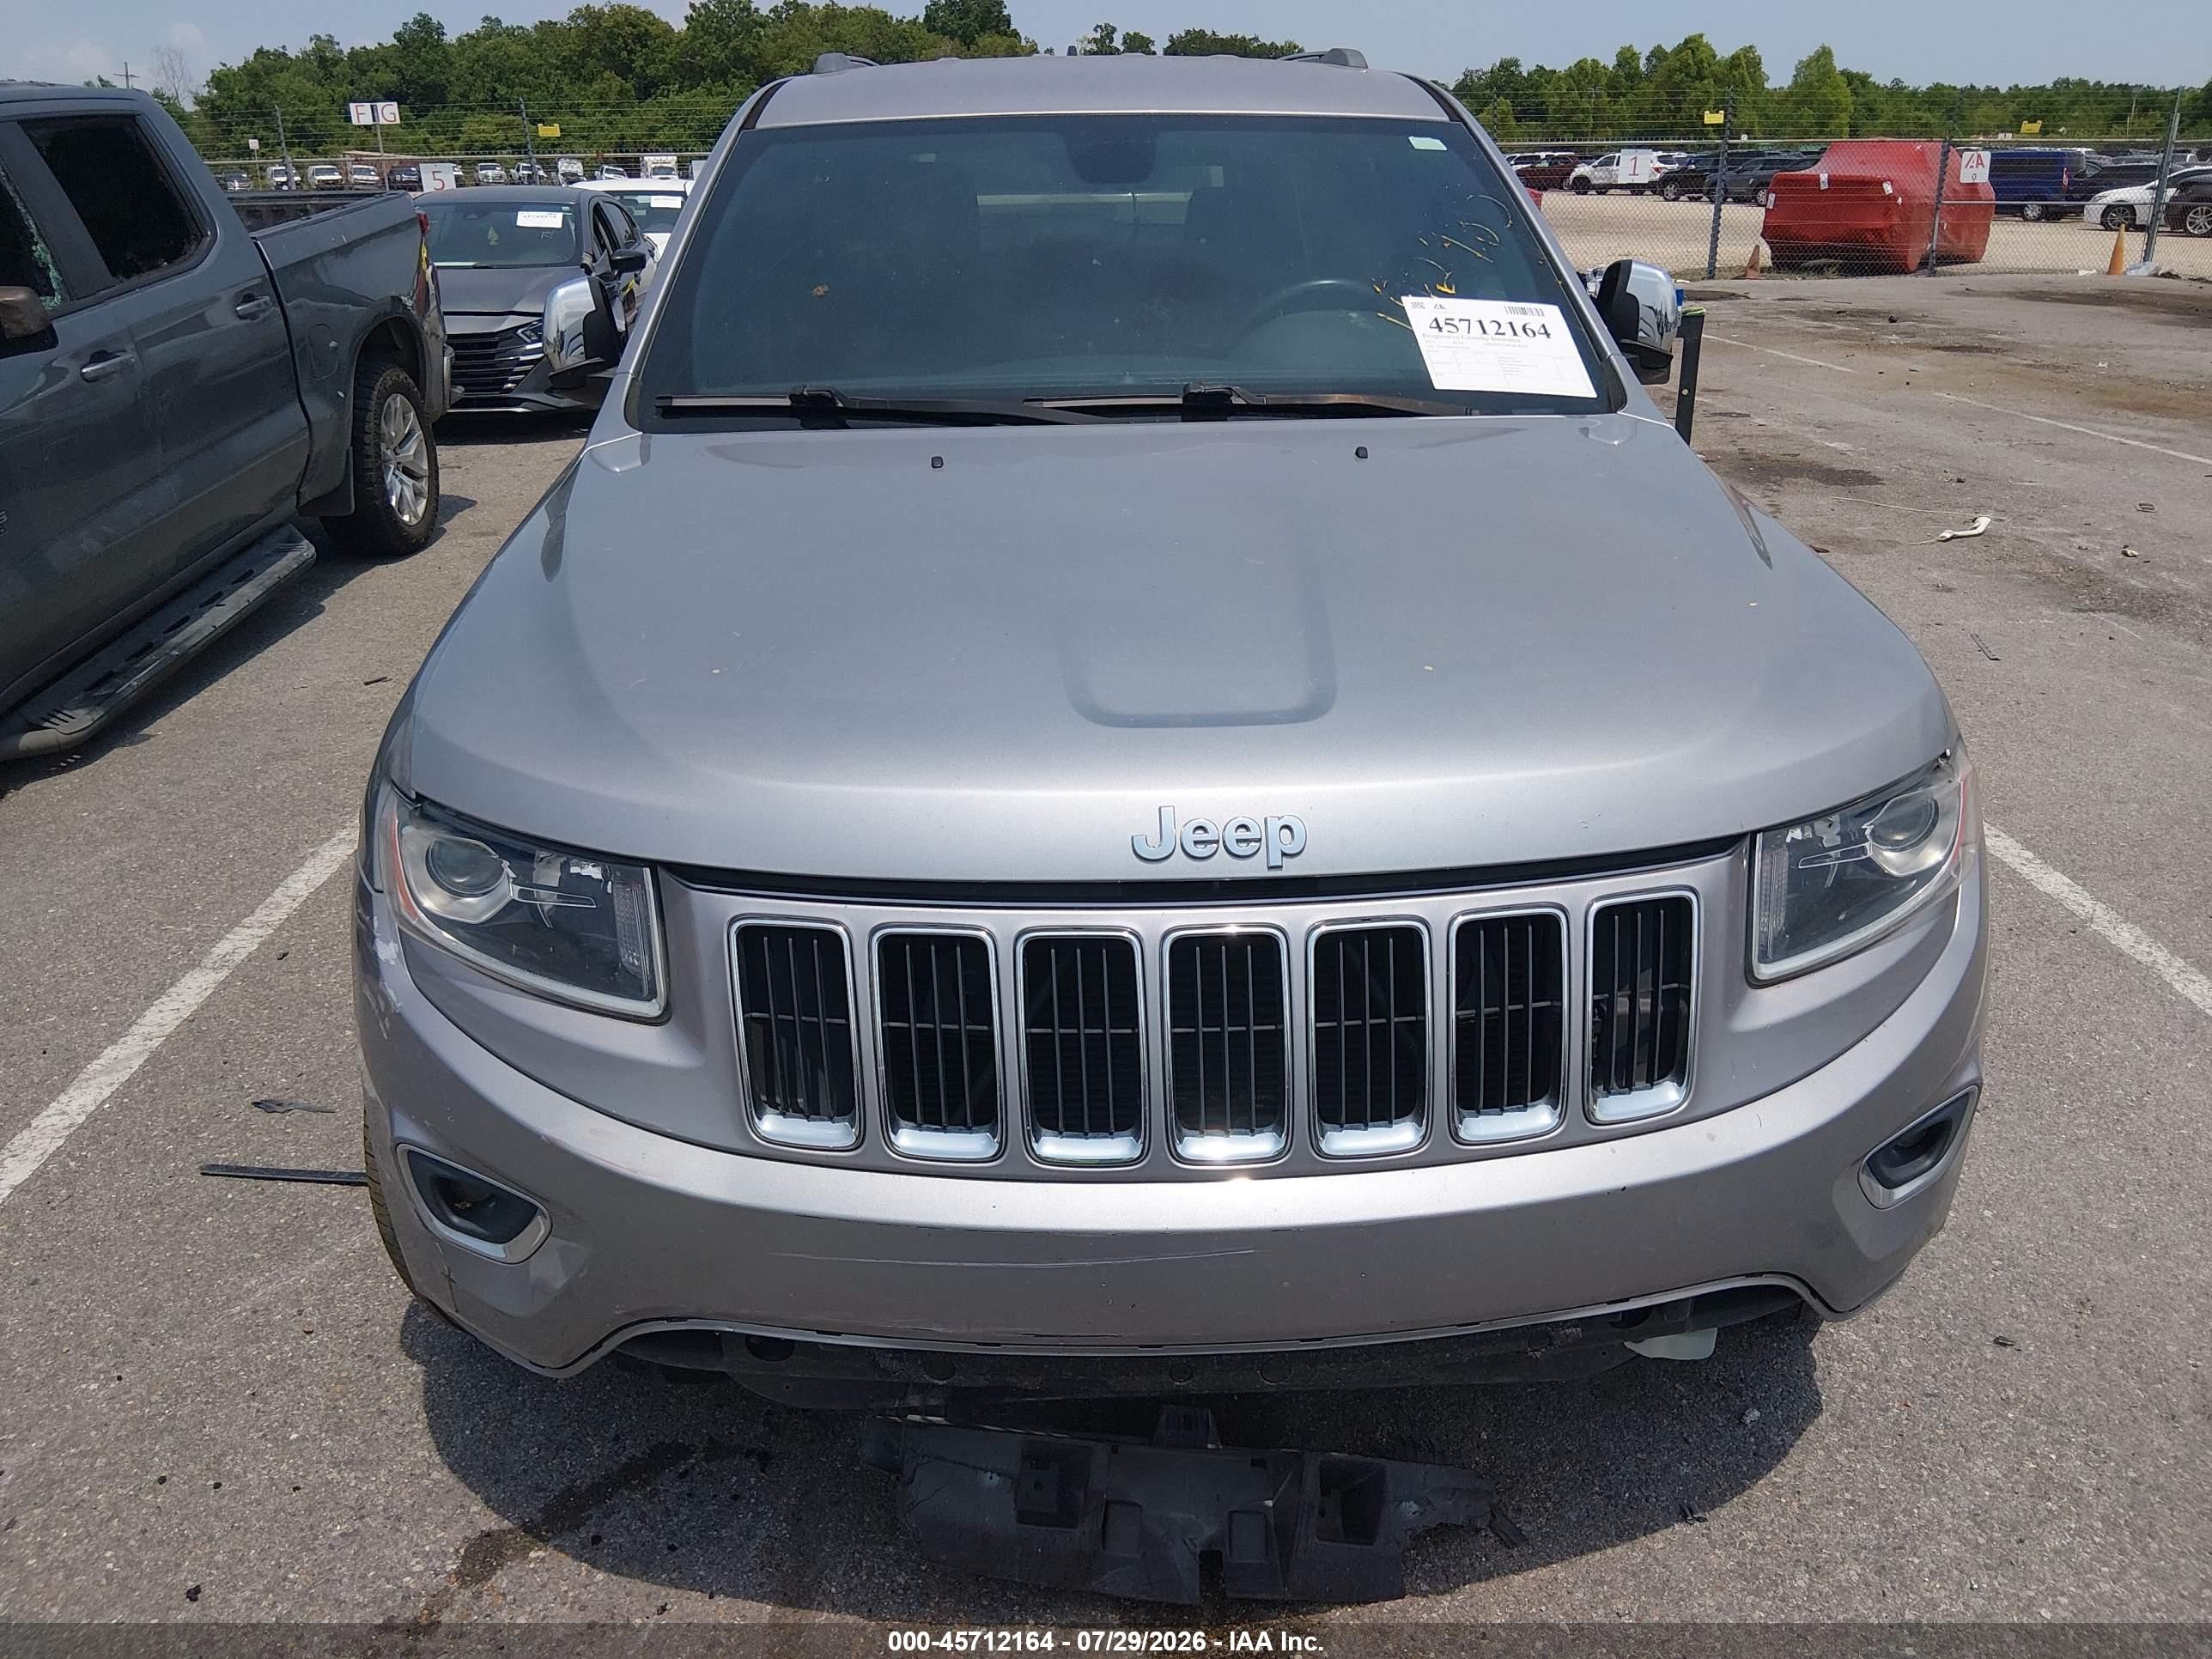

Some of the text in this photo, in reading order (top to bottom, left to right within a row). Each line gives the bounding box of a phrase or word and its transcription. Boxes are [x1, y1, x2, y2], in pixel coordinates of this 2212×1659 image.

[355, 103, 397, 124] F G
[1628, 155, 1639, 176] 1
[432, 170, 445, 191] 5
[1429, 316, 1552, 339] 45712164
[1131, 805, 1308, 871] Jeep
